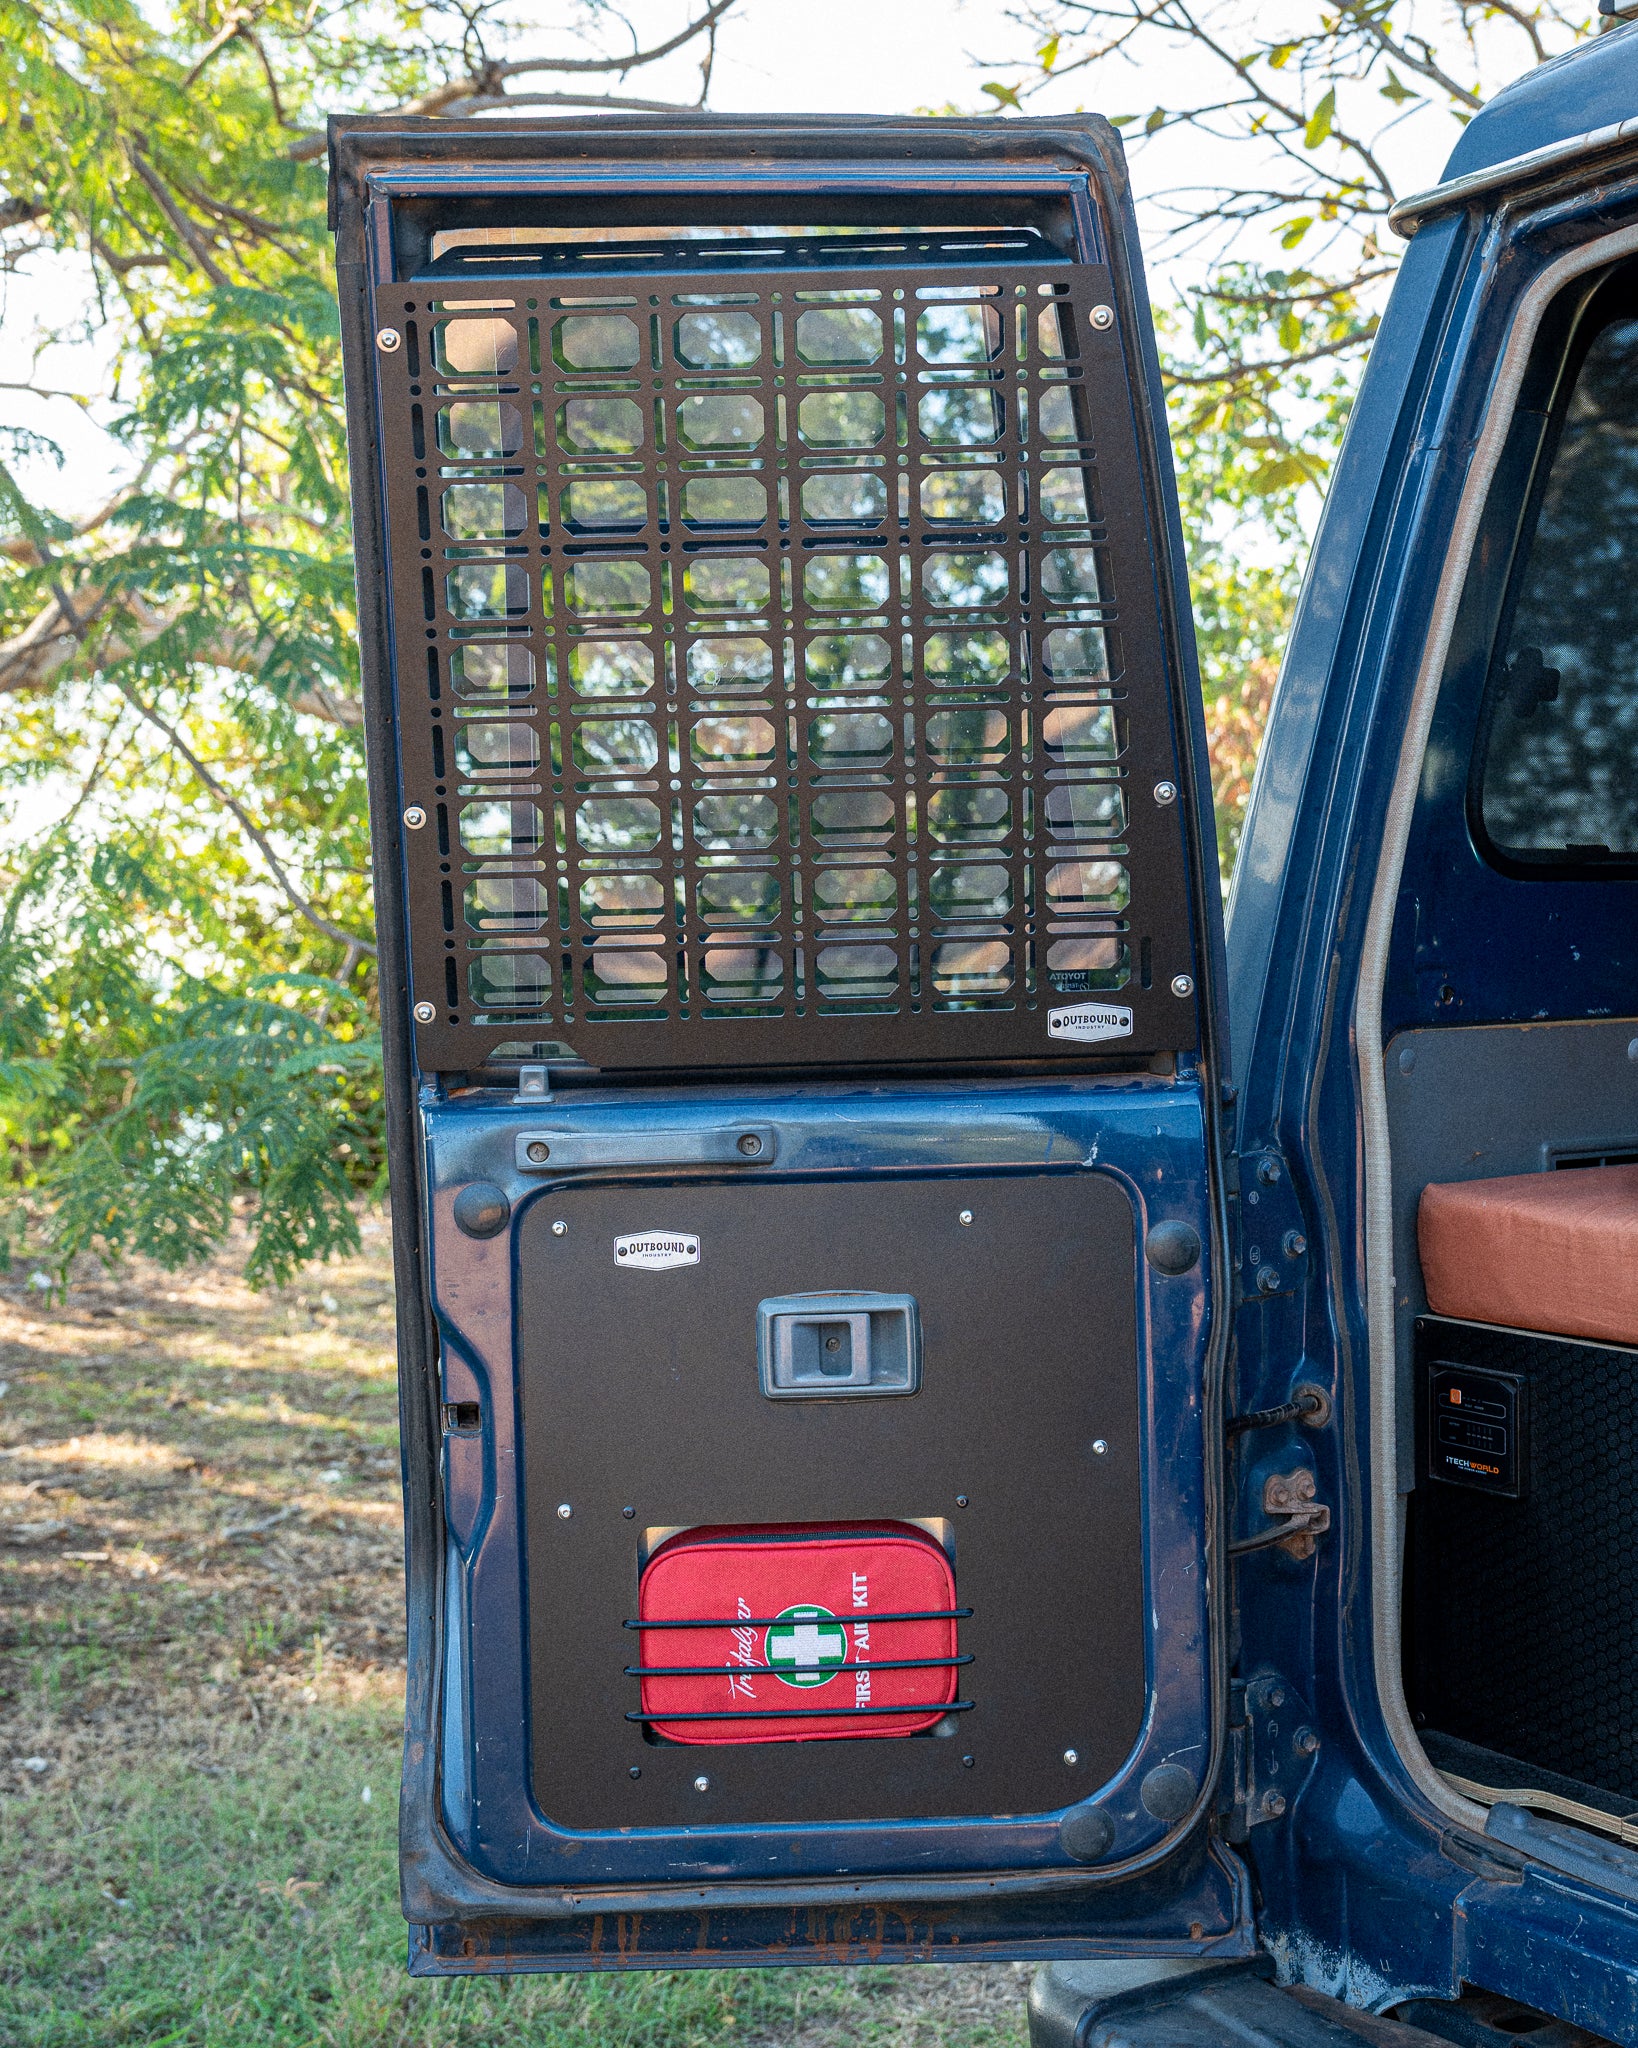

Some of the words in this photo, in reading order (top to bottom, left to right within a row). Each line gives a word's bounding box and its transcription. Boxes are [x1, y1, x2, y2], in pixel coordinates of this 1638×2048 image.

[1063, 1014, 1118, 1027] OUTBOUND
[629, 1242, 685, 1254] OUTBOUND
[852, 1572, 868, 1608] KIT
[726, 1597, 764, 1699] Trfalgar
